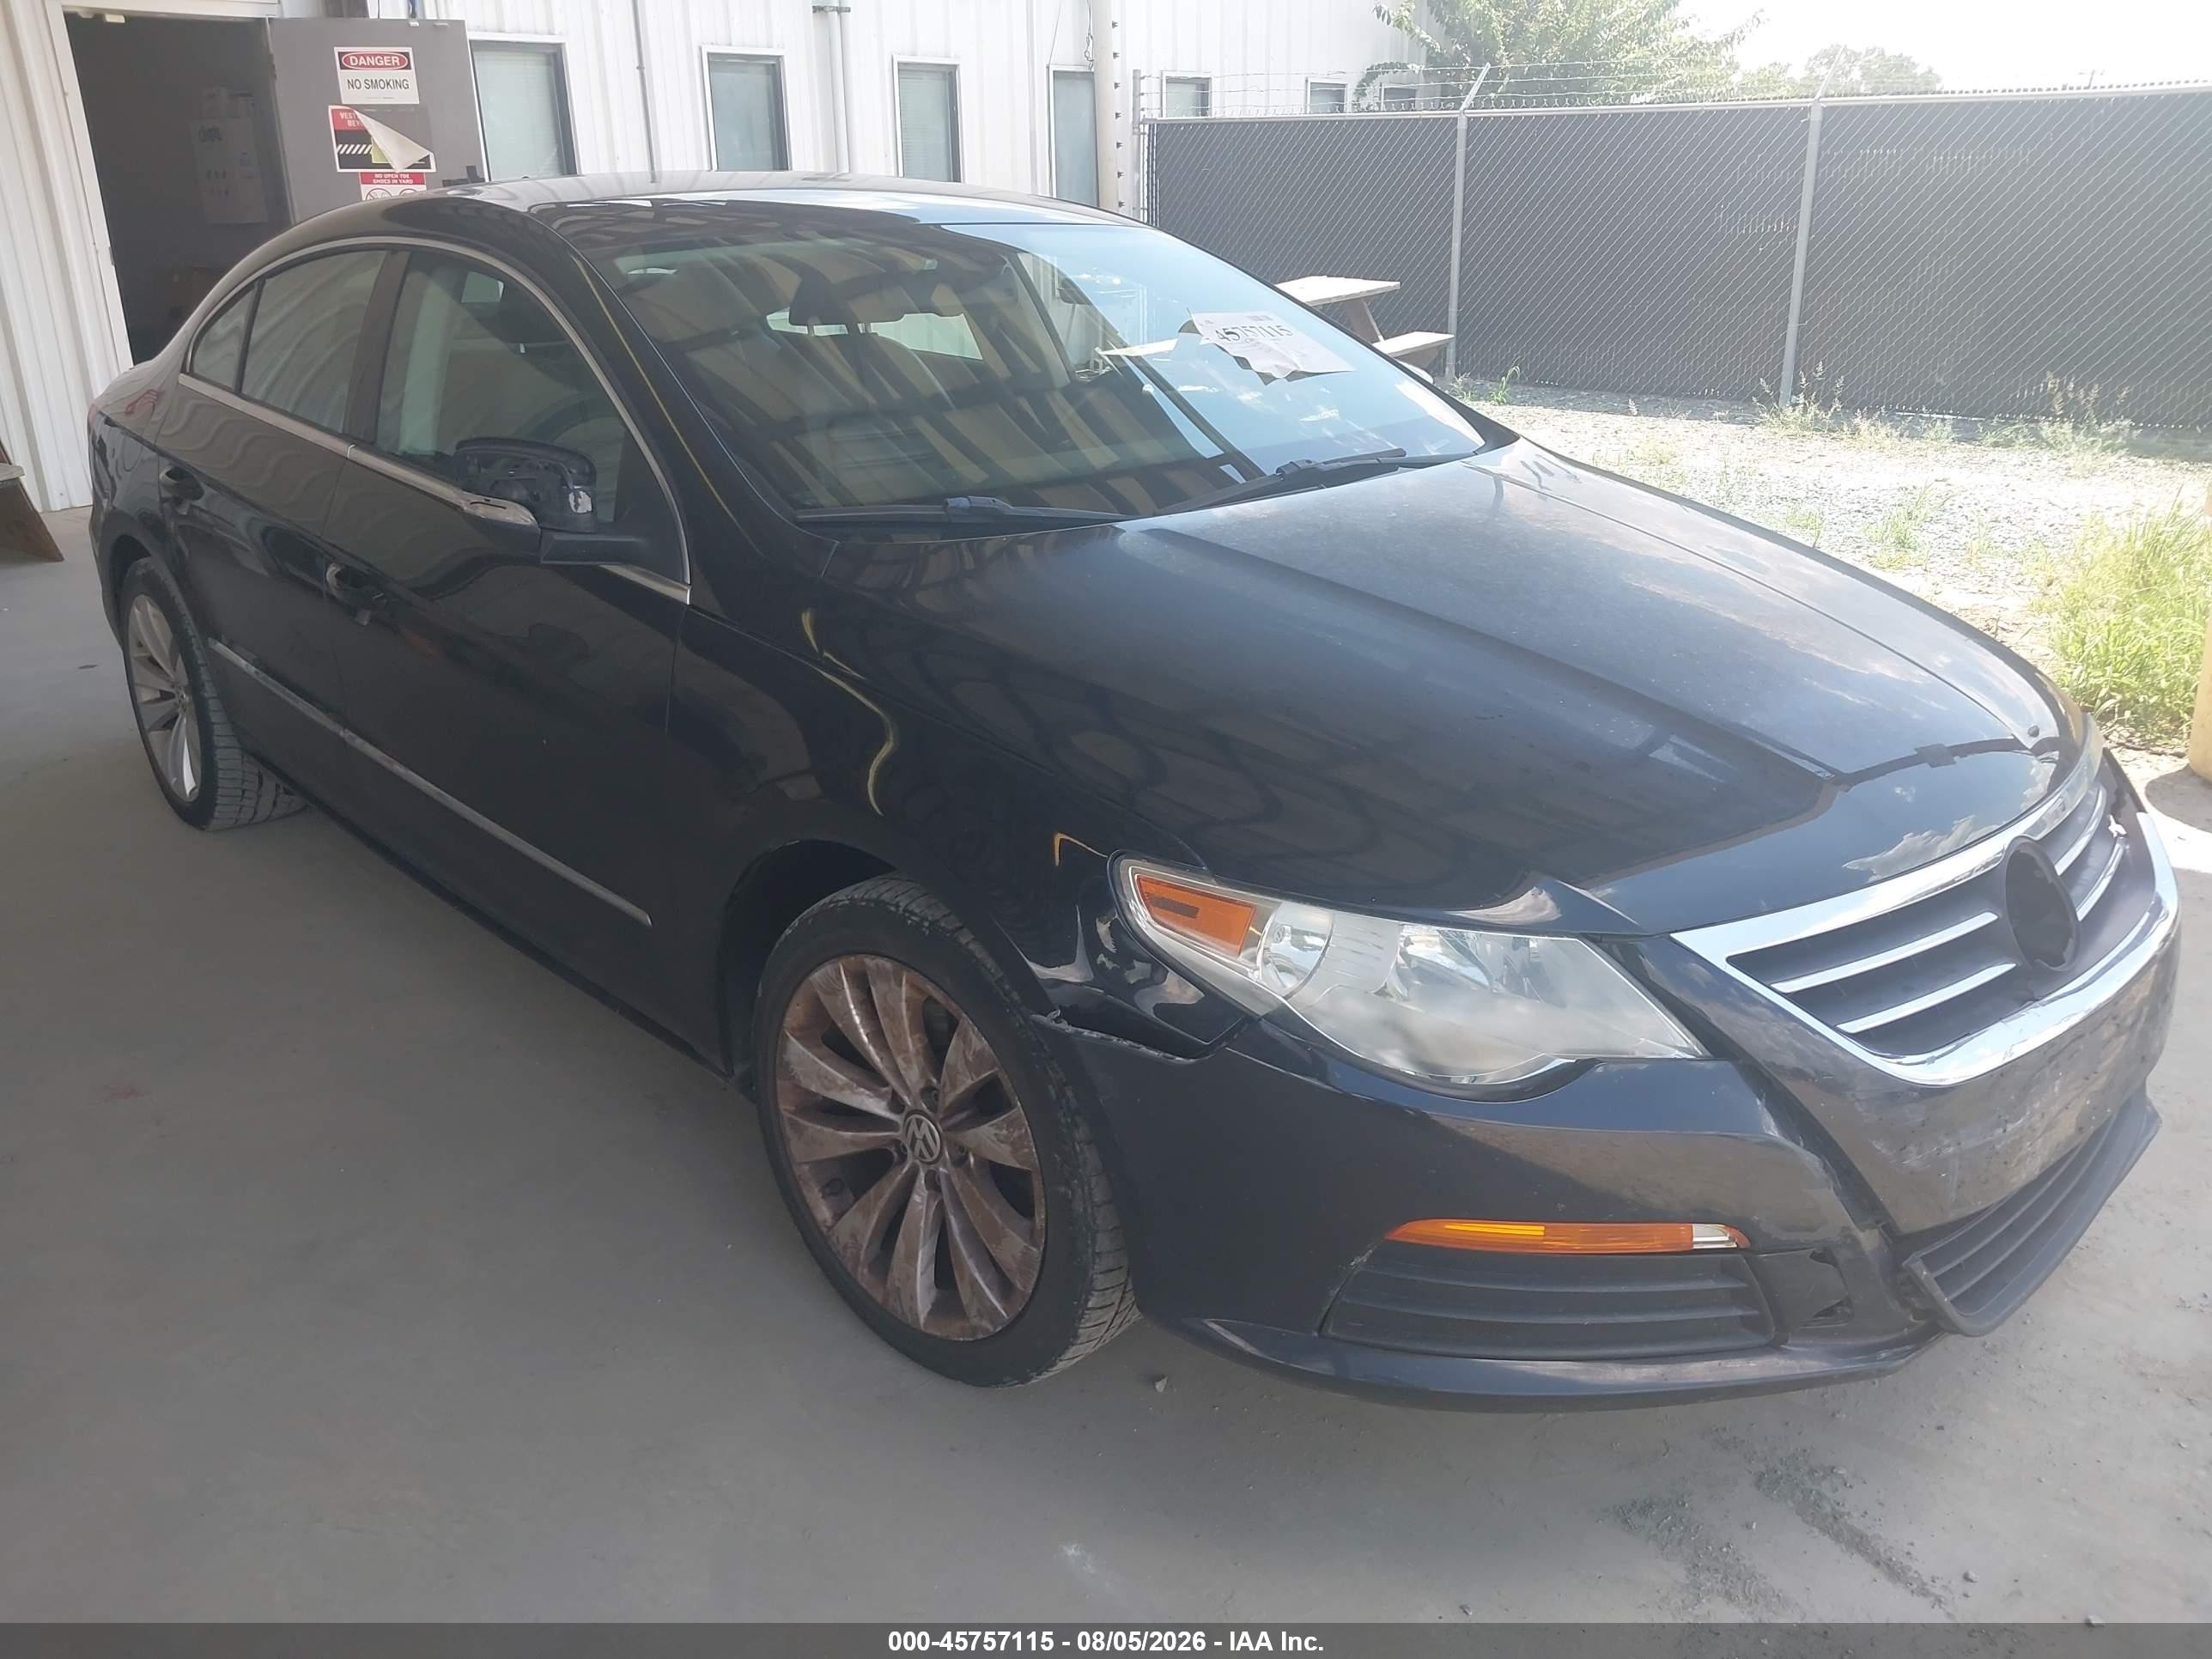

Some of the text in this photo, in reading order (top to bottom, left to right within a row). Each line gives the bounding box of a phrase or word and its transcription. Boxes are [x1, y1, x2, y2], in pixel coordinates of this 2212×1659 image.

[349, 55, 400, 66] DANGER
[347, 78, 410, 89] NO SMOKING
[1215, 325, 1294, 342] 45757115
